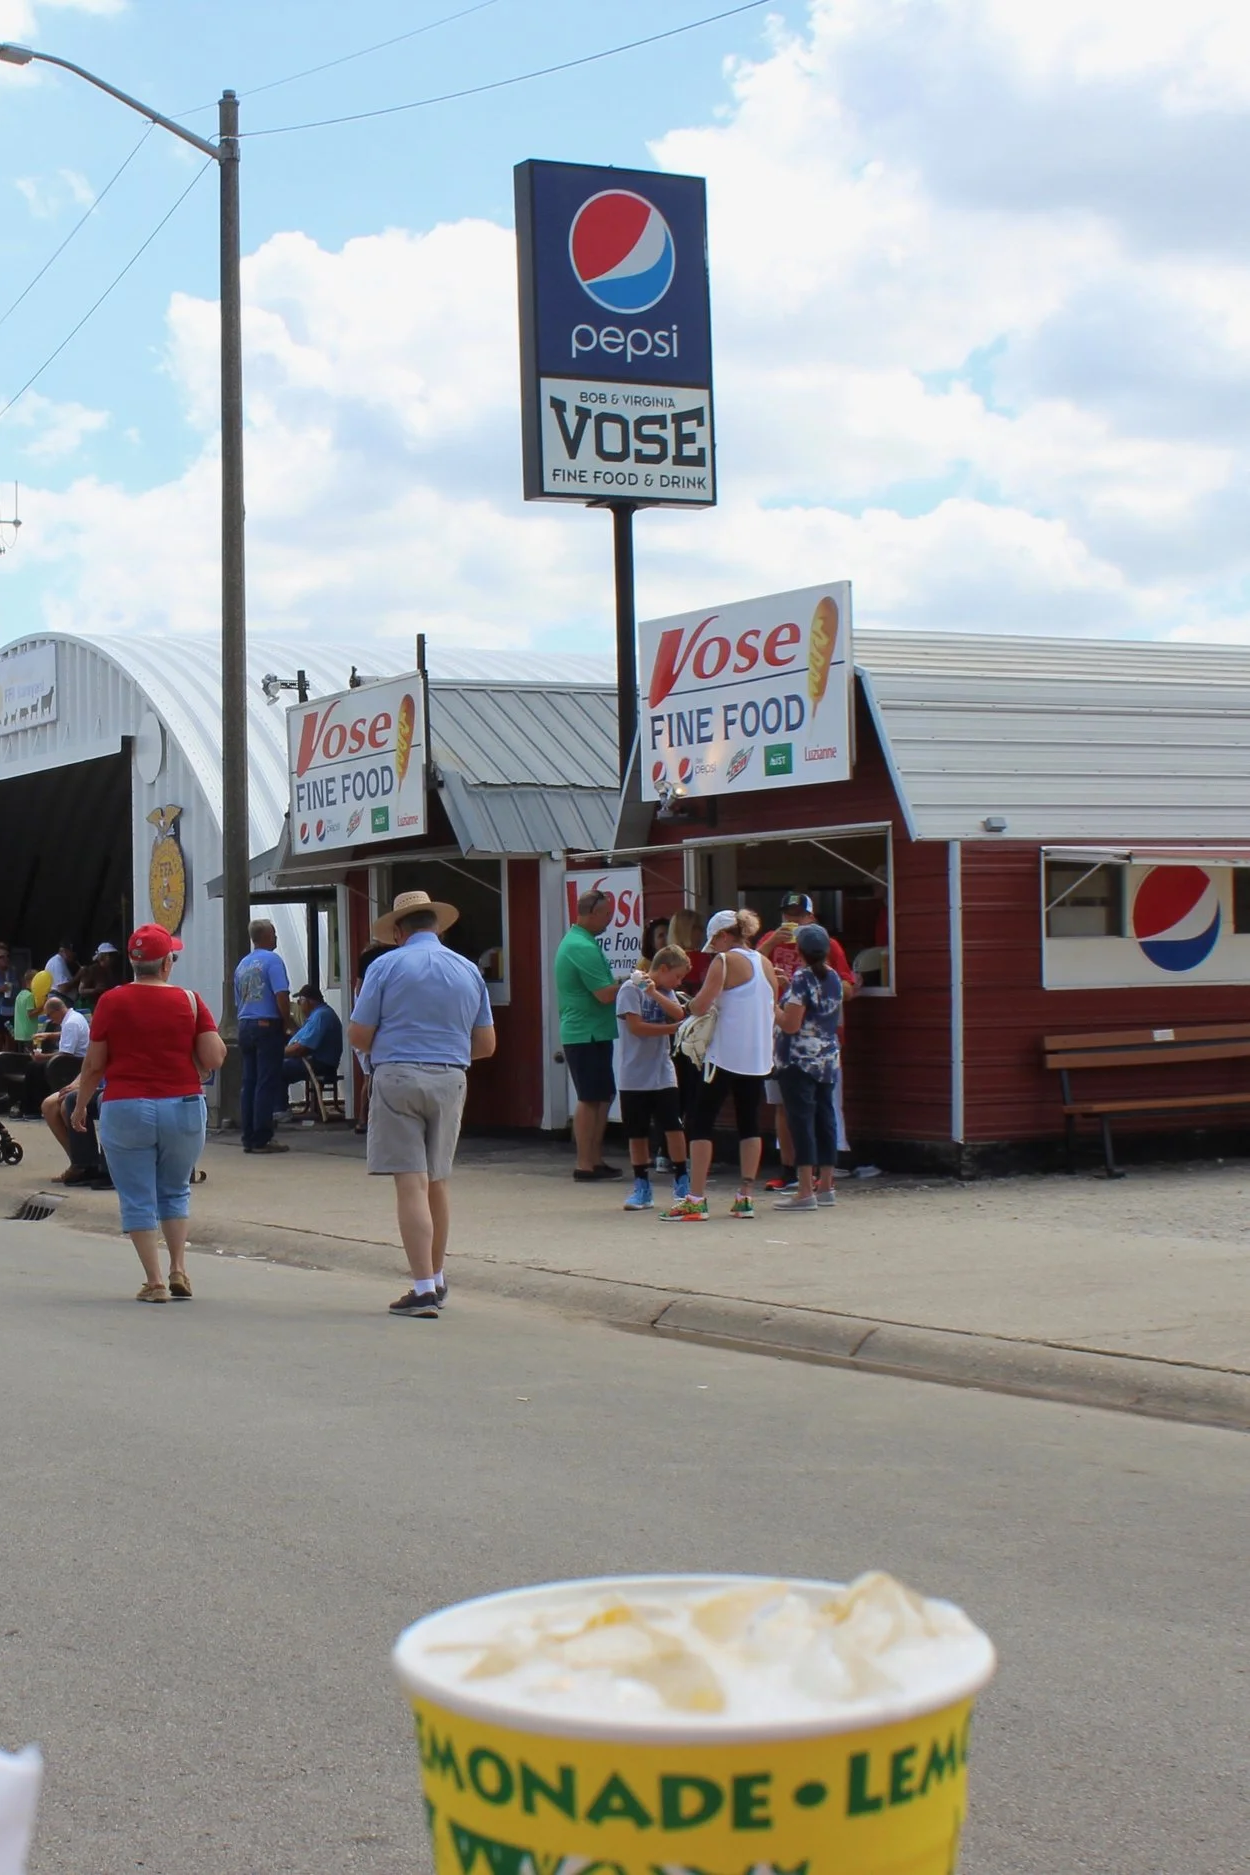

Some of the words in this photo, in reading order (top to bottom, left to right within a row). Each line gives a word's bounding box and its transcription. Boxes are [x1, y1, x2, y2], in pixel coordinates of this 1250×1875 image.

[571, 323, 678, 363] pepsi
[580, 391, 607, 405] BOB
[611, 395, 619, 405] &
[622, 394, 676, 409] VIRGINIA
[550, 395, 707, 468] VOSE
[552, 468, 588, 484] FINE
[593, 470, 638, 487] FOOD
[644, 473, 654, 487] &
[660, 474, 707, 490] DRINK
[649, 615, 801, 709] Vose
[296, 700, 392, 778] Vose
[650, 706, 714, 750] FINE
[722, 693, 805, 741] FOOD
[694, 763, 717, 775] pepsi
[804, 745, 837, 762] Luzianne
[296, 776, 338, 813] FINE
[341, 765, 394, 804] FOOD
[609, 955, 637, 972] erving
[845, 1725, 969, 1818] LEM
